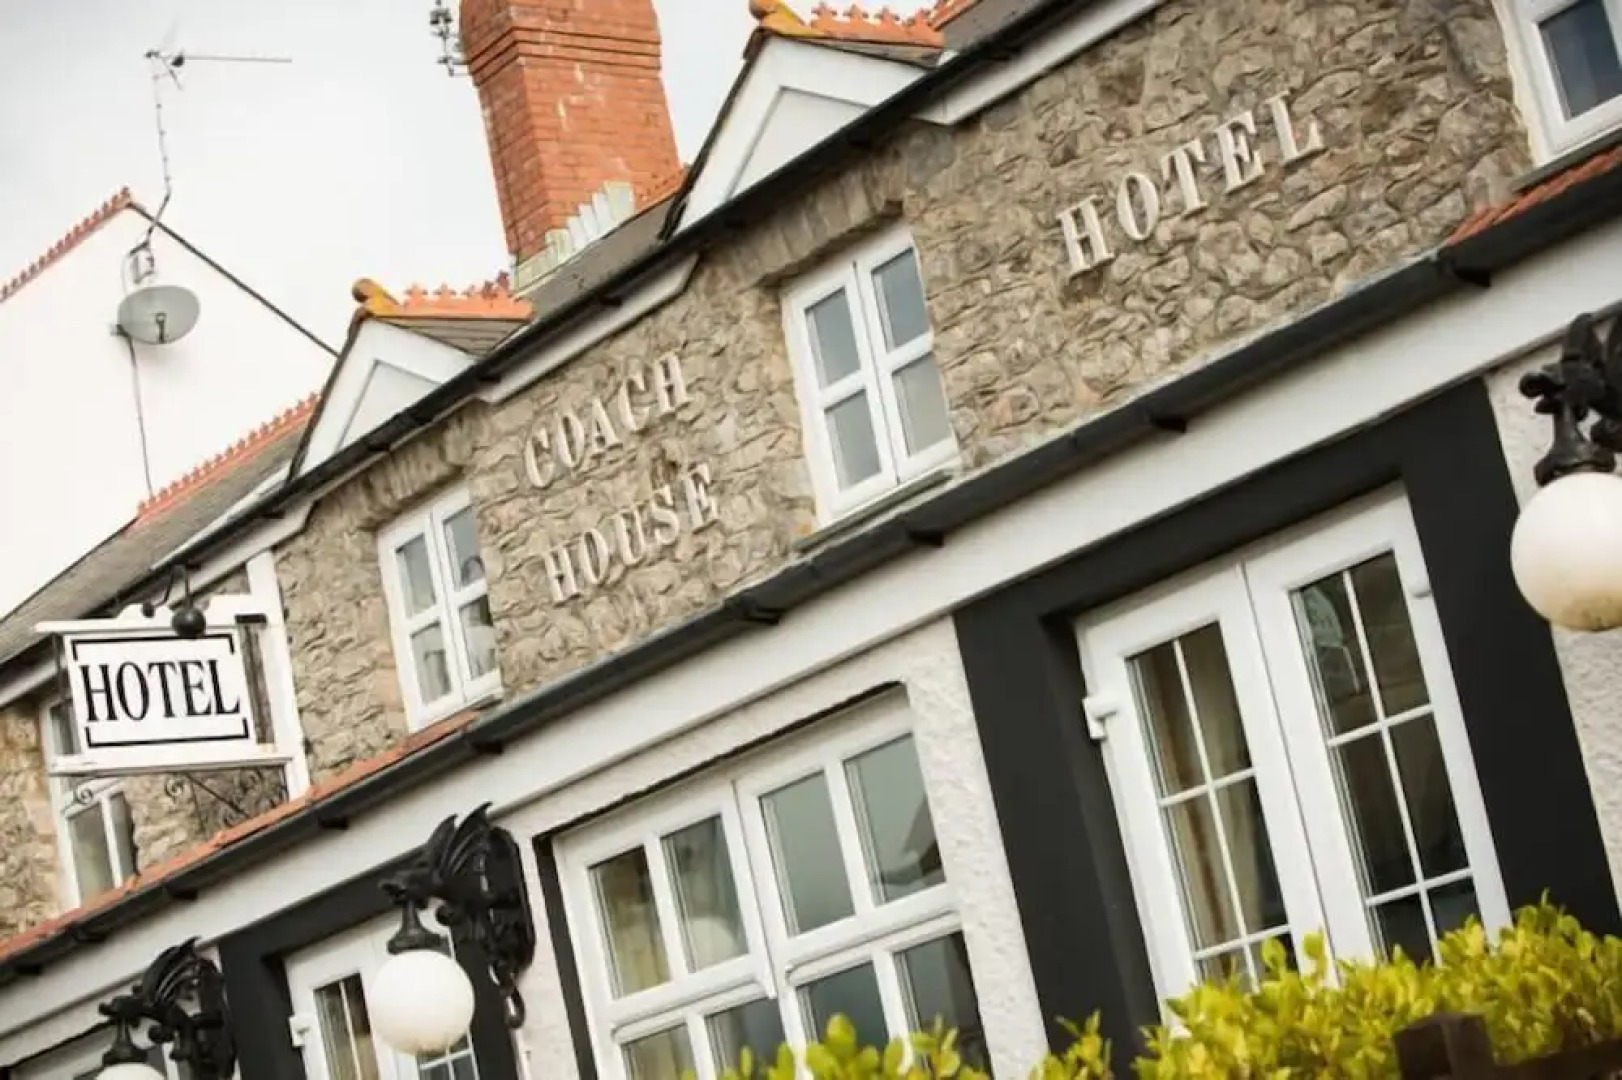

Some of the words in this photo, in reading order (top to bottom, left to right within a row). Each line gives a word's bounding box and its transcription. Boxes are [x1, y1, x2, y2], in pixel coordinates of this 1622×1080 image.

[1056, 91, 1326, 275] HOTEL
[524, 352, 689, 488] COACH
[544, 463, 719, 602] HOUSE
[79, 659, 241, 722] HOTEL
